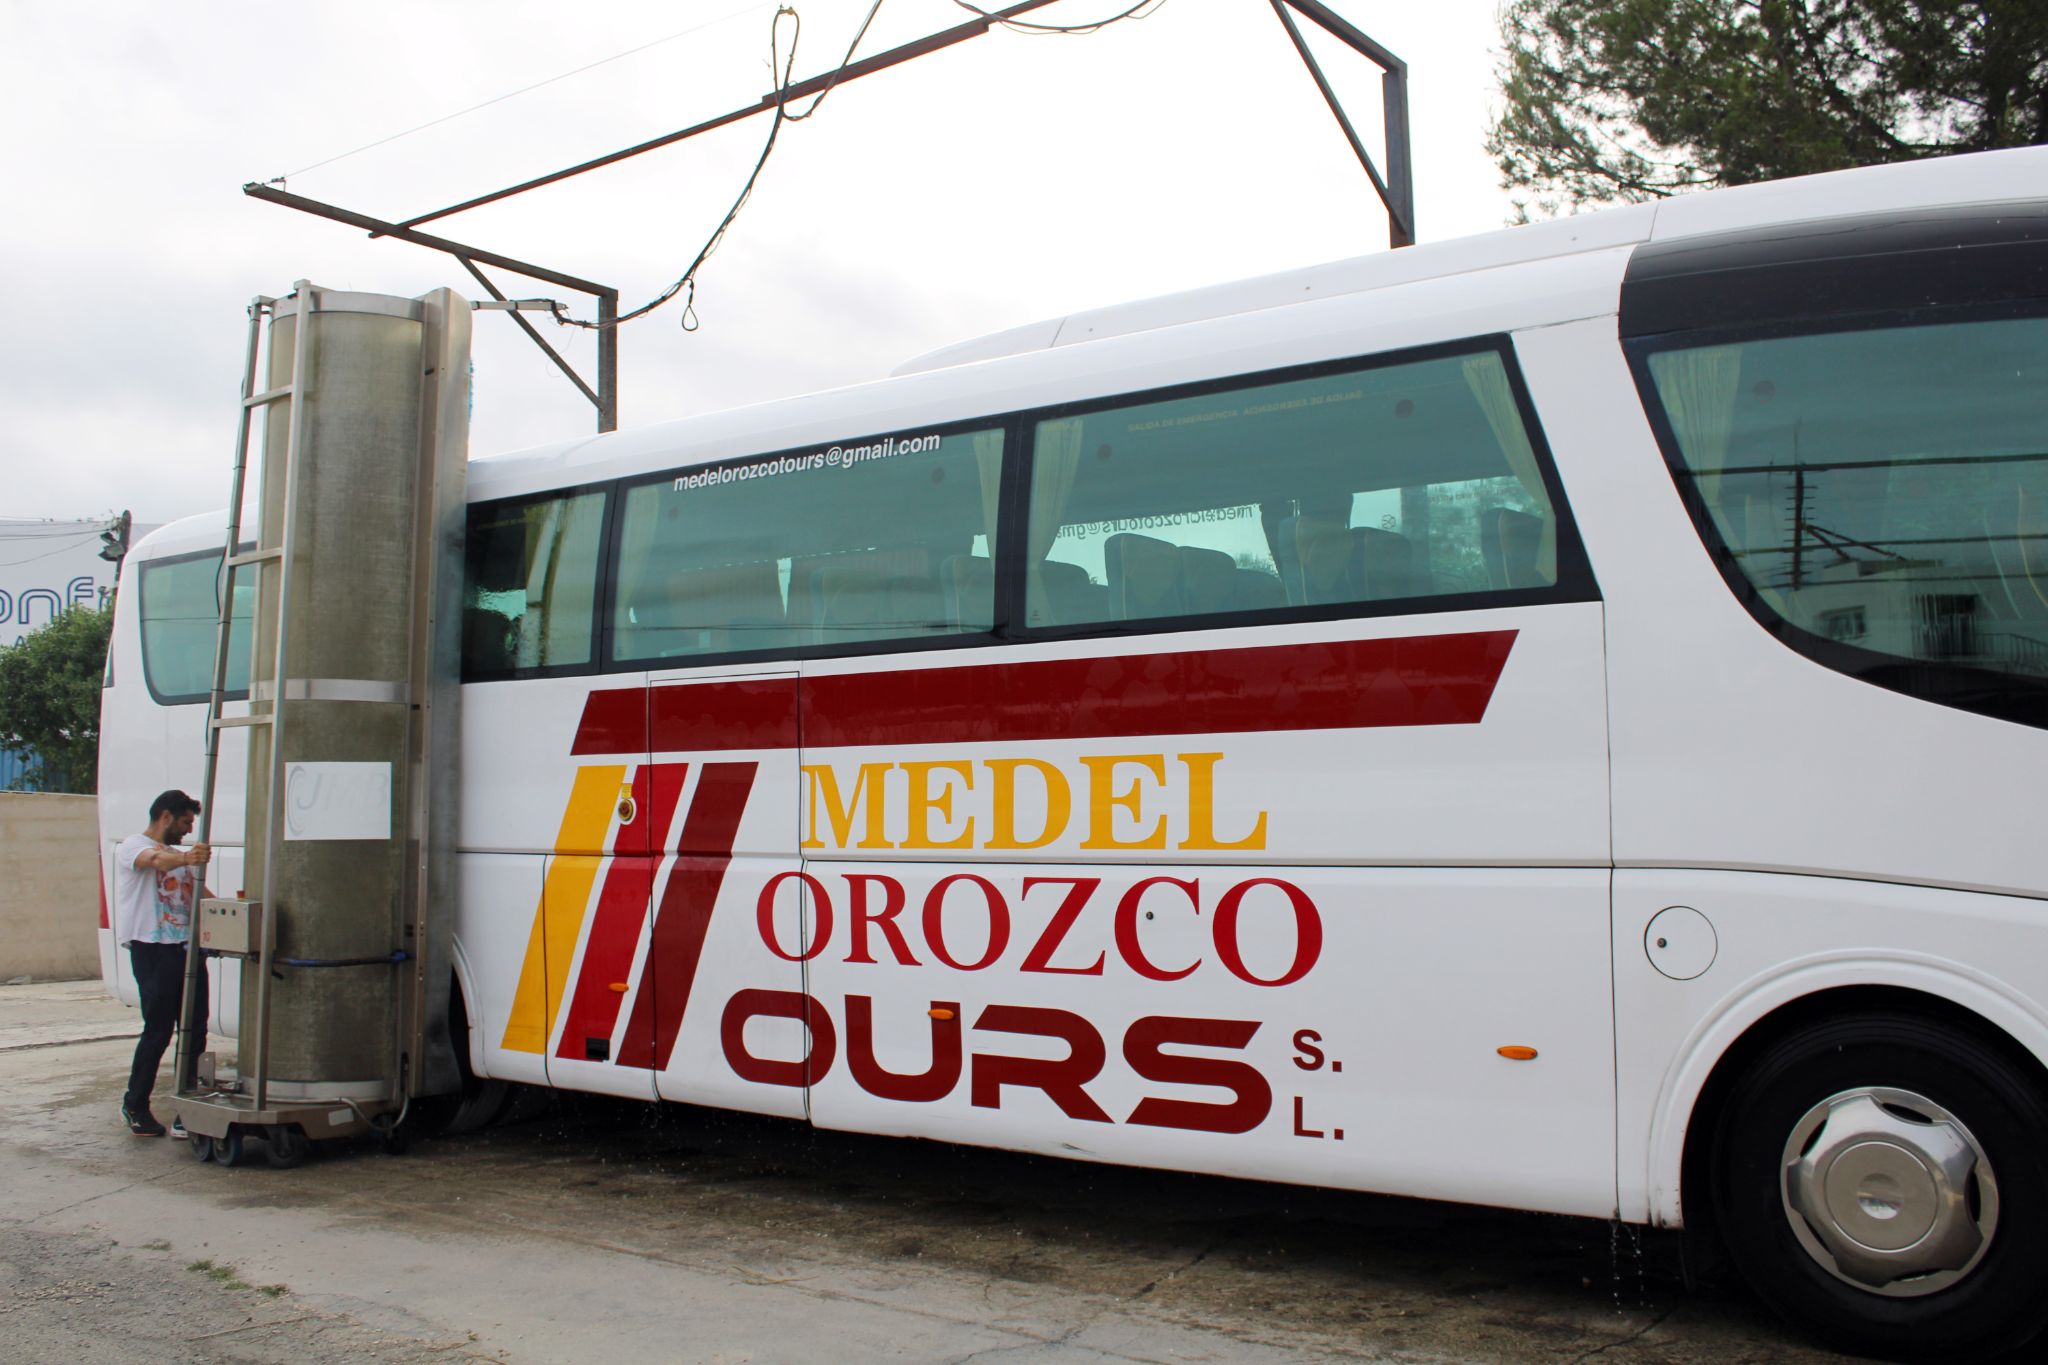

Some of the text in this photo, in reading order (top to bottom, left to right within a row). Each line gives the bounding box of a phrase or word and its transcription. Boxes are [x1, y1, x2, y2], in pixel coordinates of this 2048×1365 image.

[673, 432, 941, 492] medelorozcotours@gmail.com
[800, 752, 1268, 851] MEDEL
[756, 871, 1323, 987] OROZCO
[1292, 1029, 1344, 1073] S.
[1293, 1096, 1344, 1140] L.
